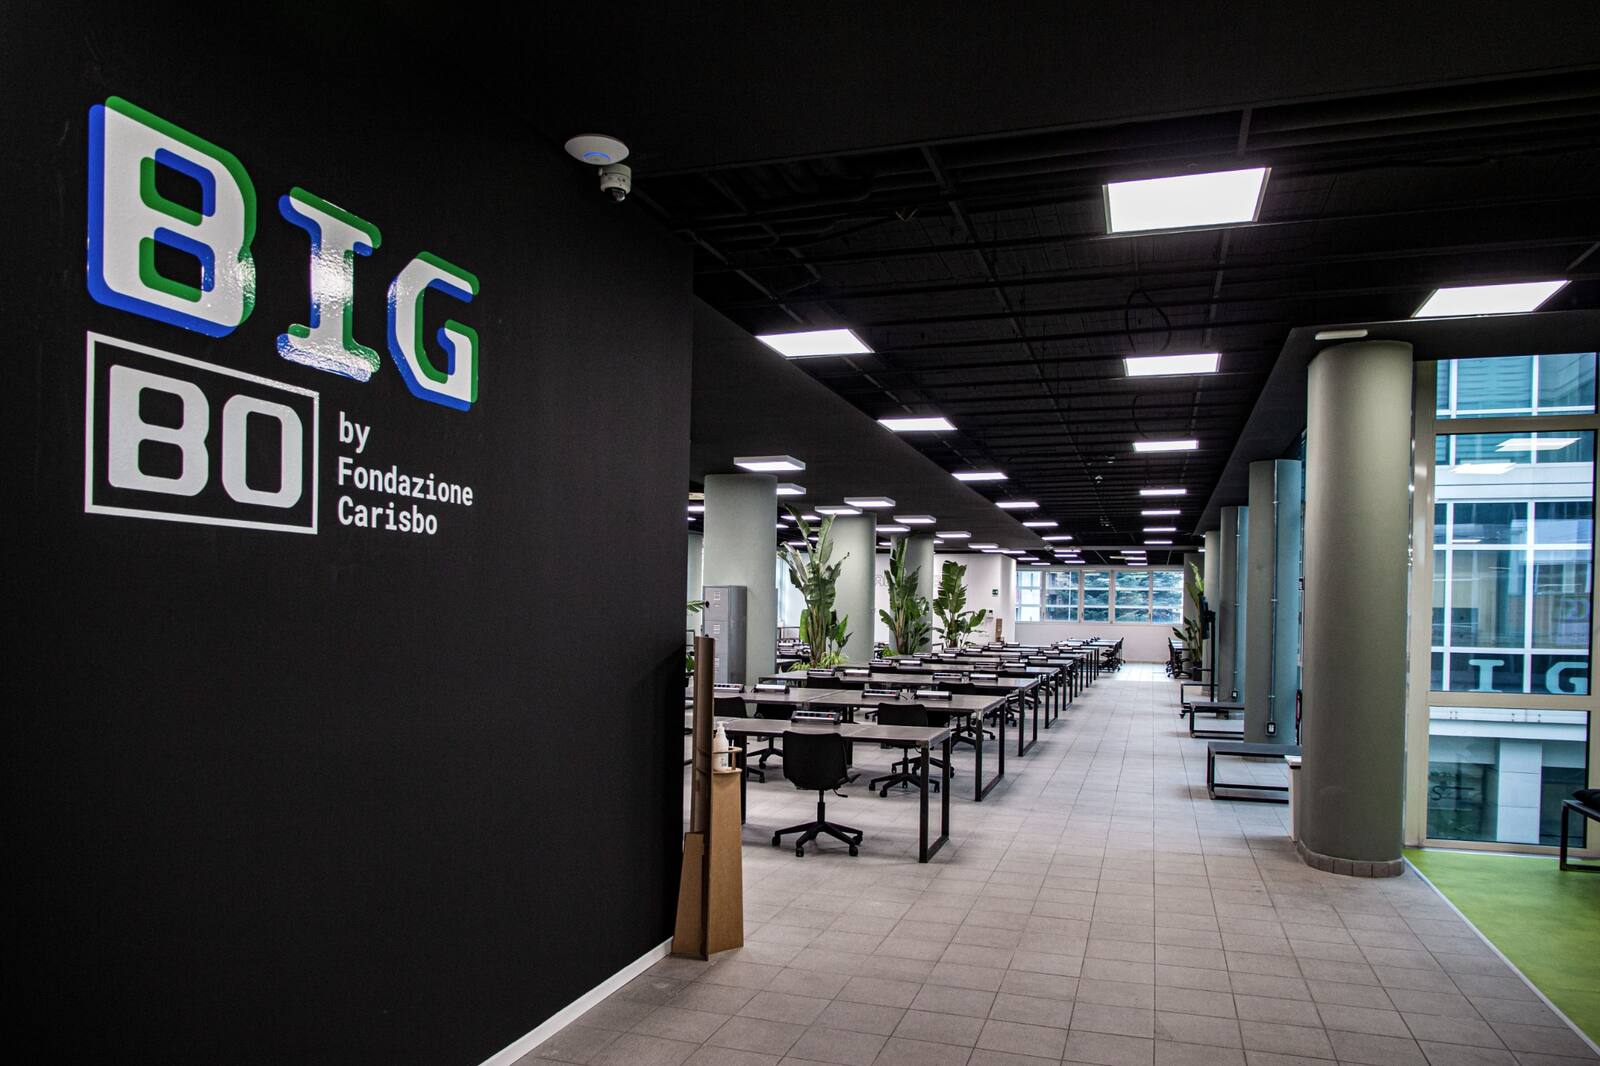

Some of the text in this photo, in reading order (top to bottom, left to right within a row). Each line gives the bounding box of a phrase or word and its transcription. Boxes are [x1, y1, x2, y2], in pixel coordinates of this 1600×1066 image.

[88, 96, 479, 412] BIG
[108, 365, 303, 508] BO
[338, 411, 371, 454] by
[337, 456, 474, 507] Fondazione
[337, 496, 438, 535] Carisbo
